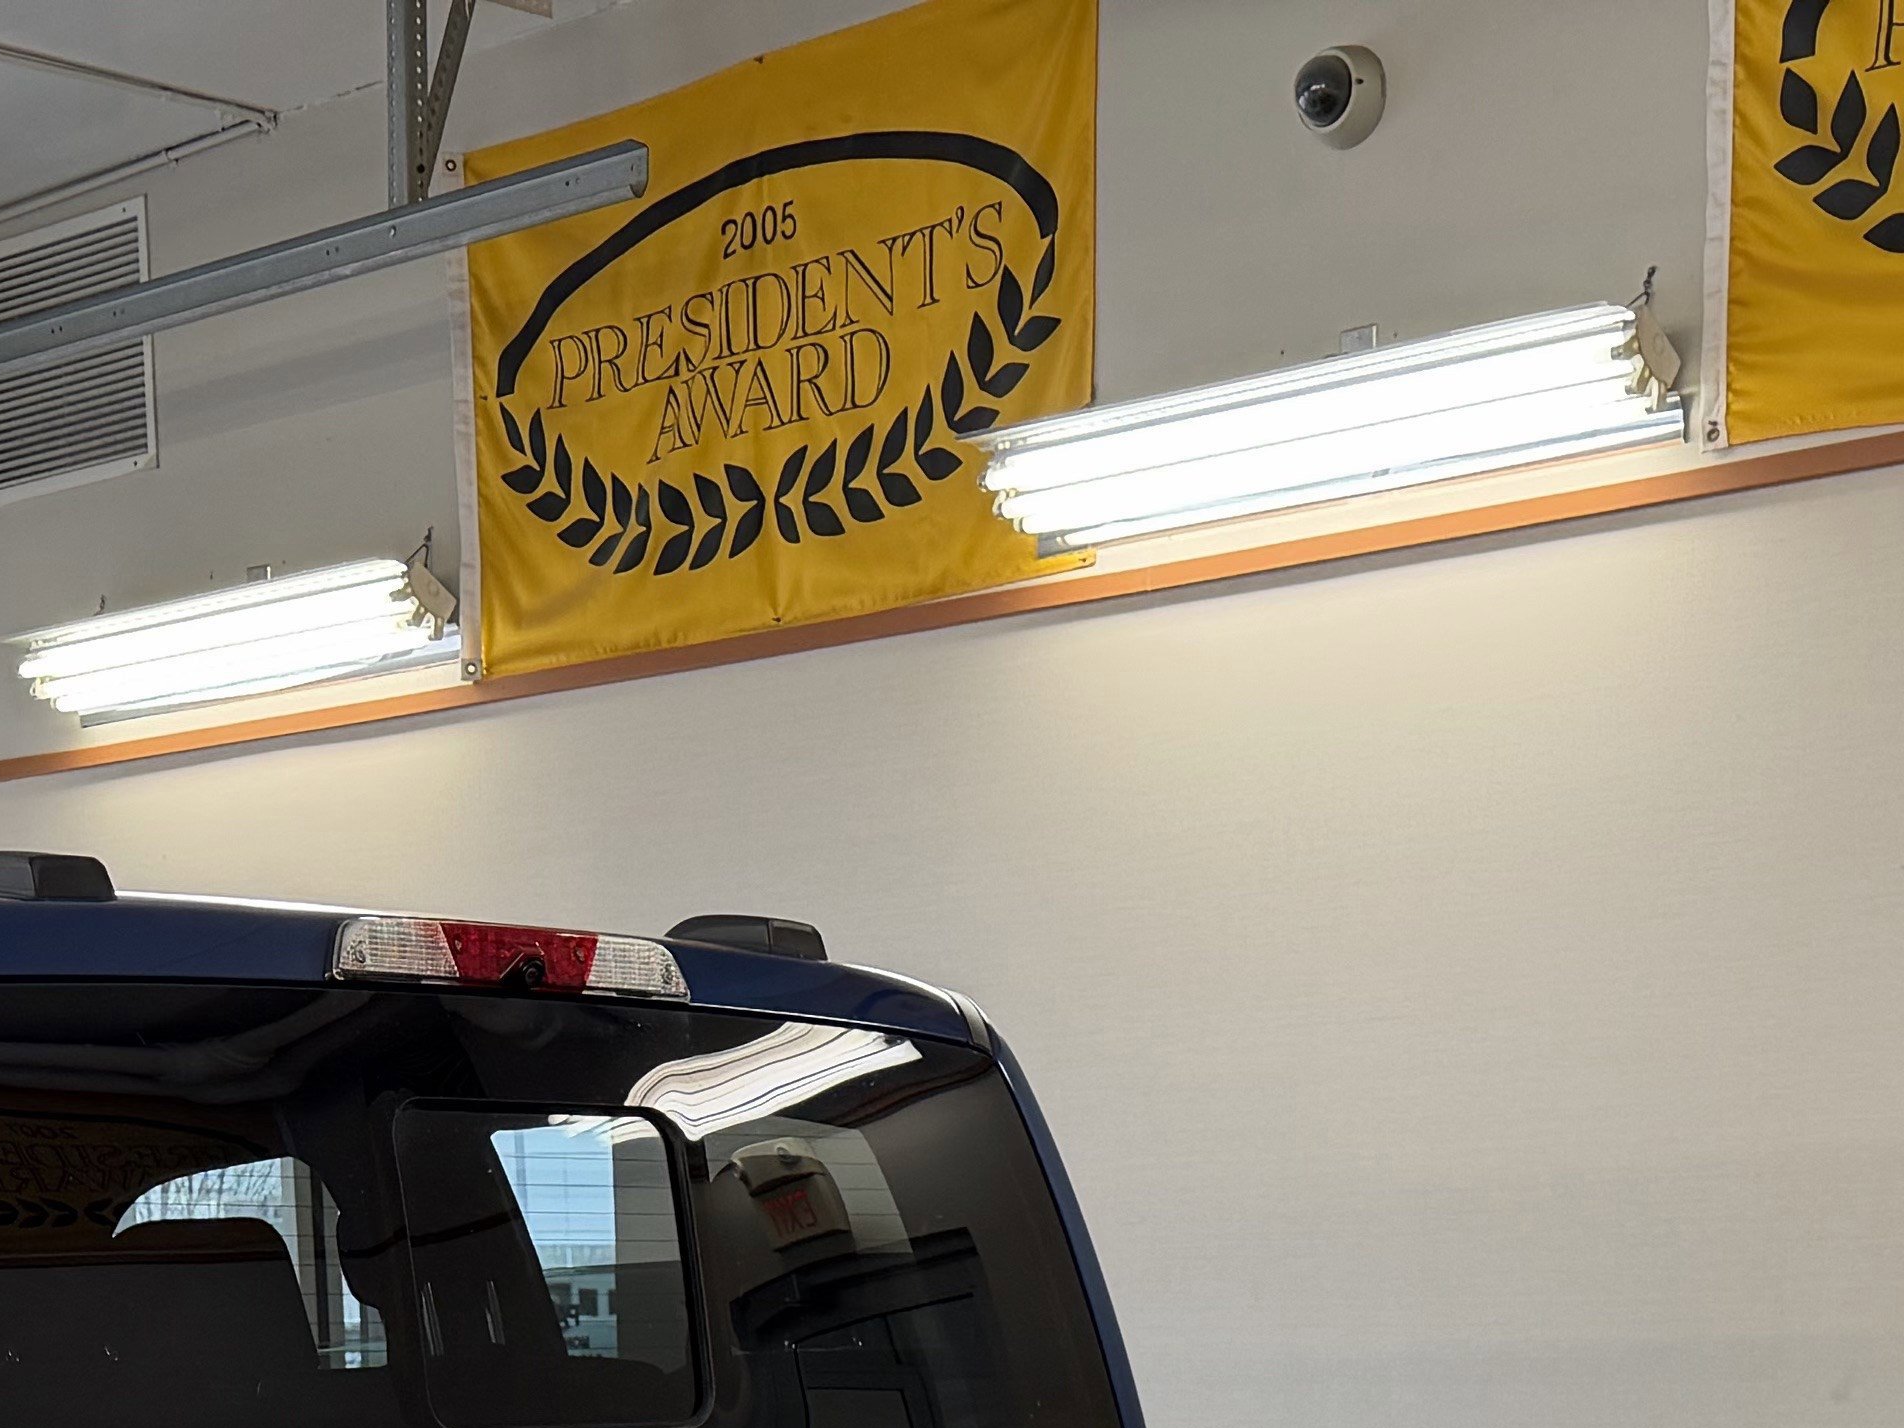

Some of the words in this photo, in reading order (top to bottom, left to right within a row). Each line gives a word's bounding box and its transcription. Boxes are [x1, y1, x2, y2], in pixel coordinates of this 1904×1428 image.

[721, 200, 798, 260] 2005
[546, 202, 1006, 410] PRESIDENT'S
[647, 327, 891, 465] AWARD
